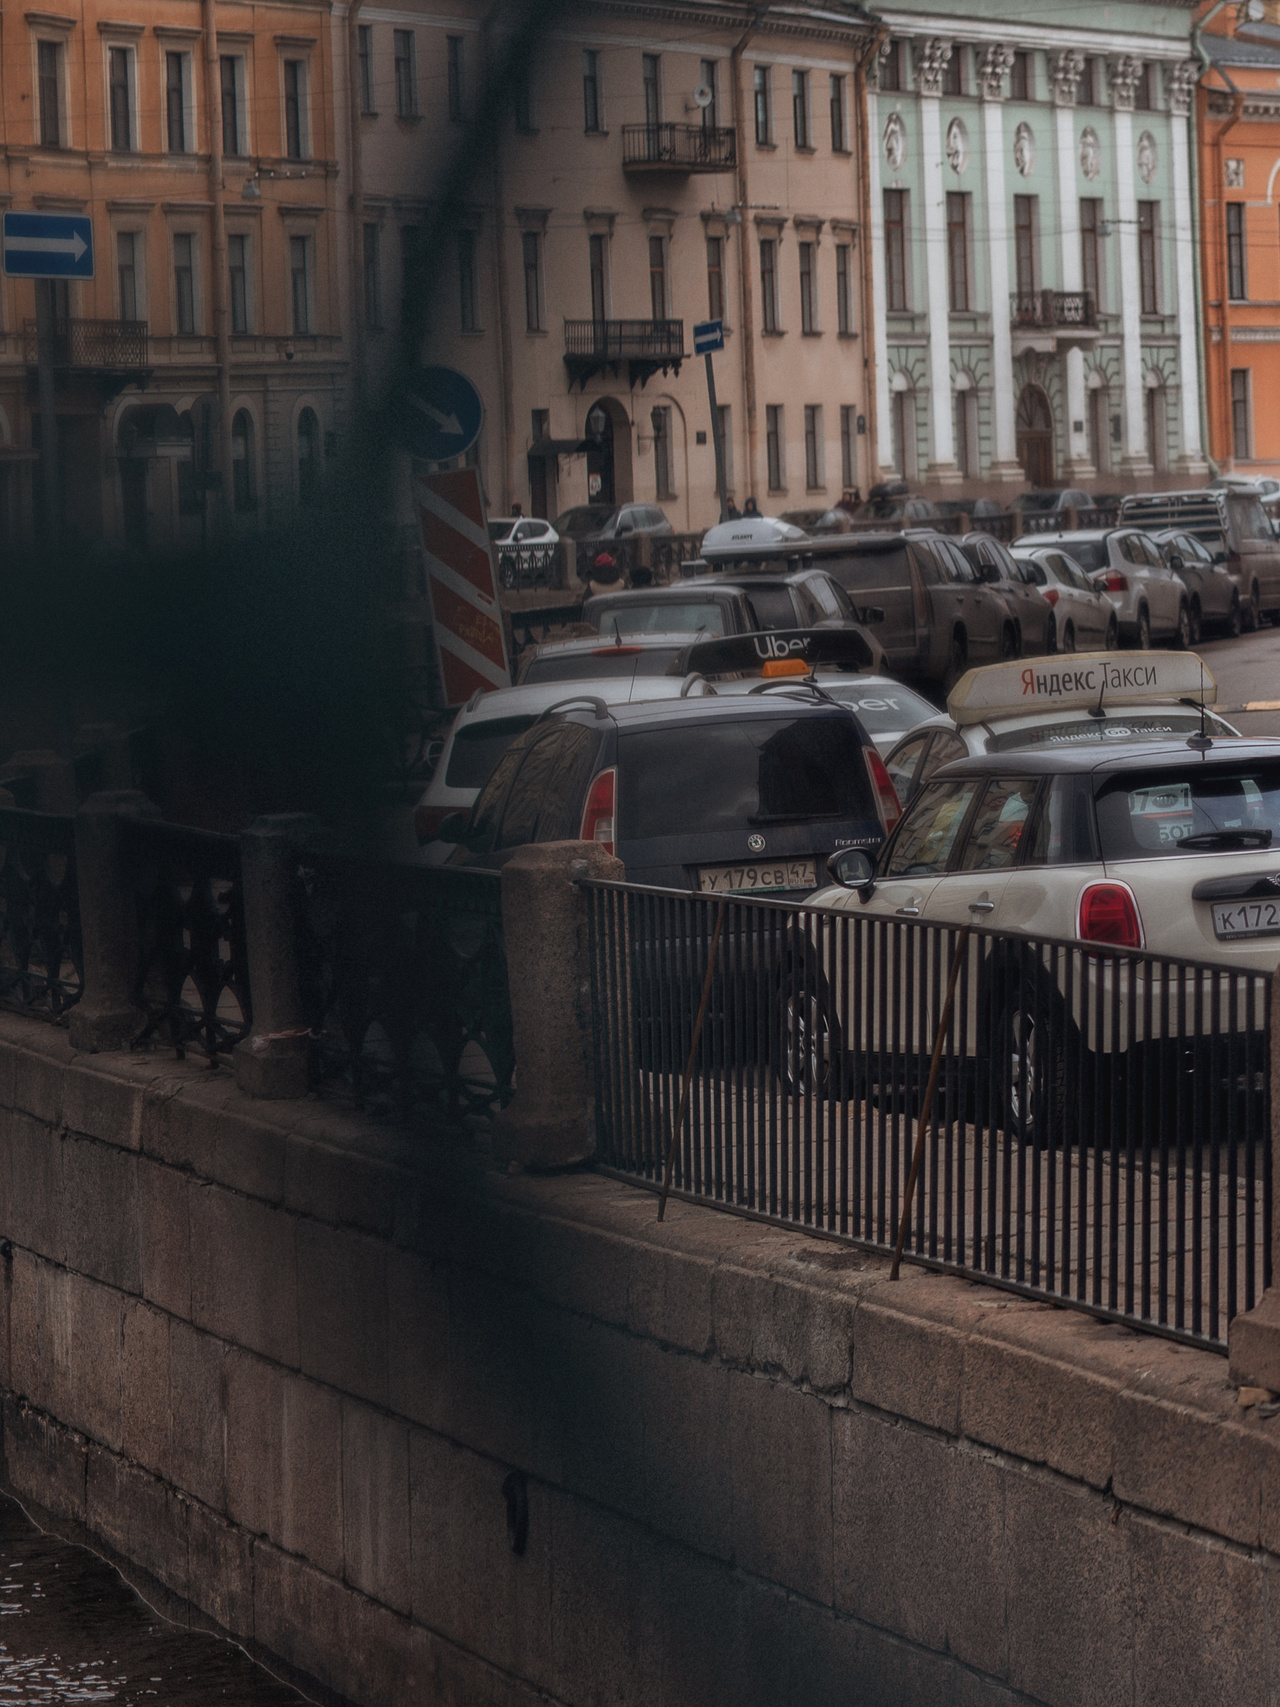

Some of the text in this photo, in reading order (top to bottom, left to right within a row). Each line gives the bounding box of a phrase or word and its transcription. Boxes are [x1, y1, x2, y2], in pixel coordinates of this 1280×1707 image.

[753, 635, 811, 659] Uber
[1021, 662, 1157, 696] Яндекс Такси
[1050, 731, 1102, 743] Яндекс
[1131, 726, 1173, 734] Такси
